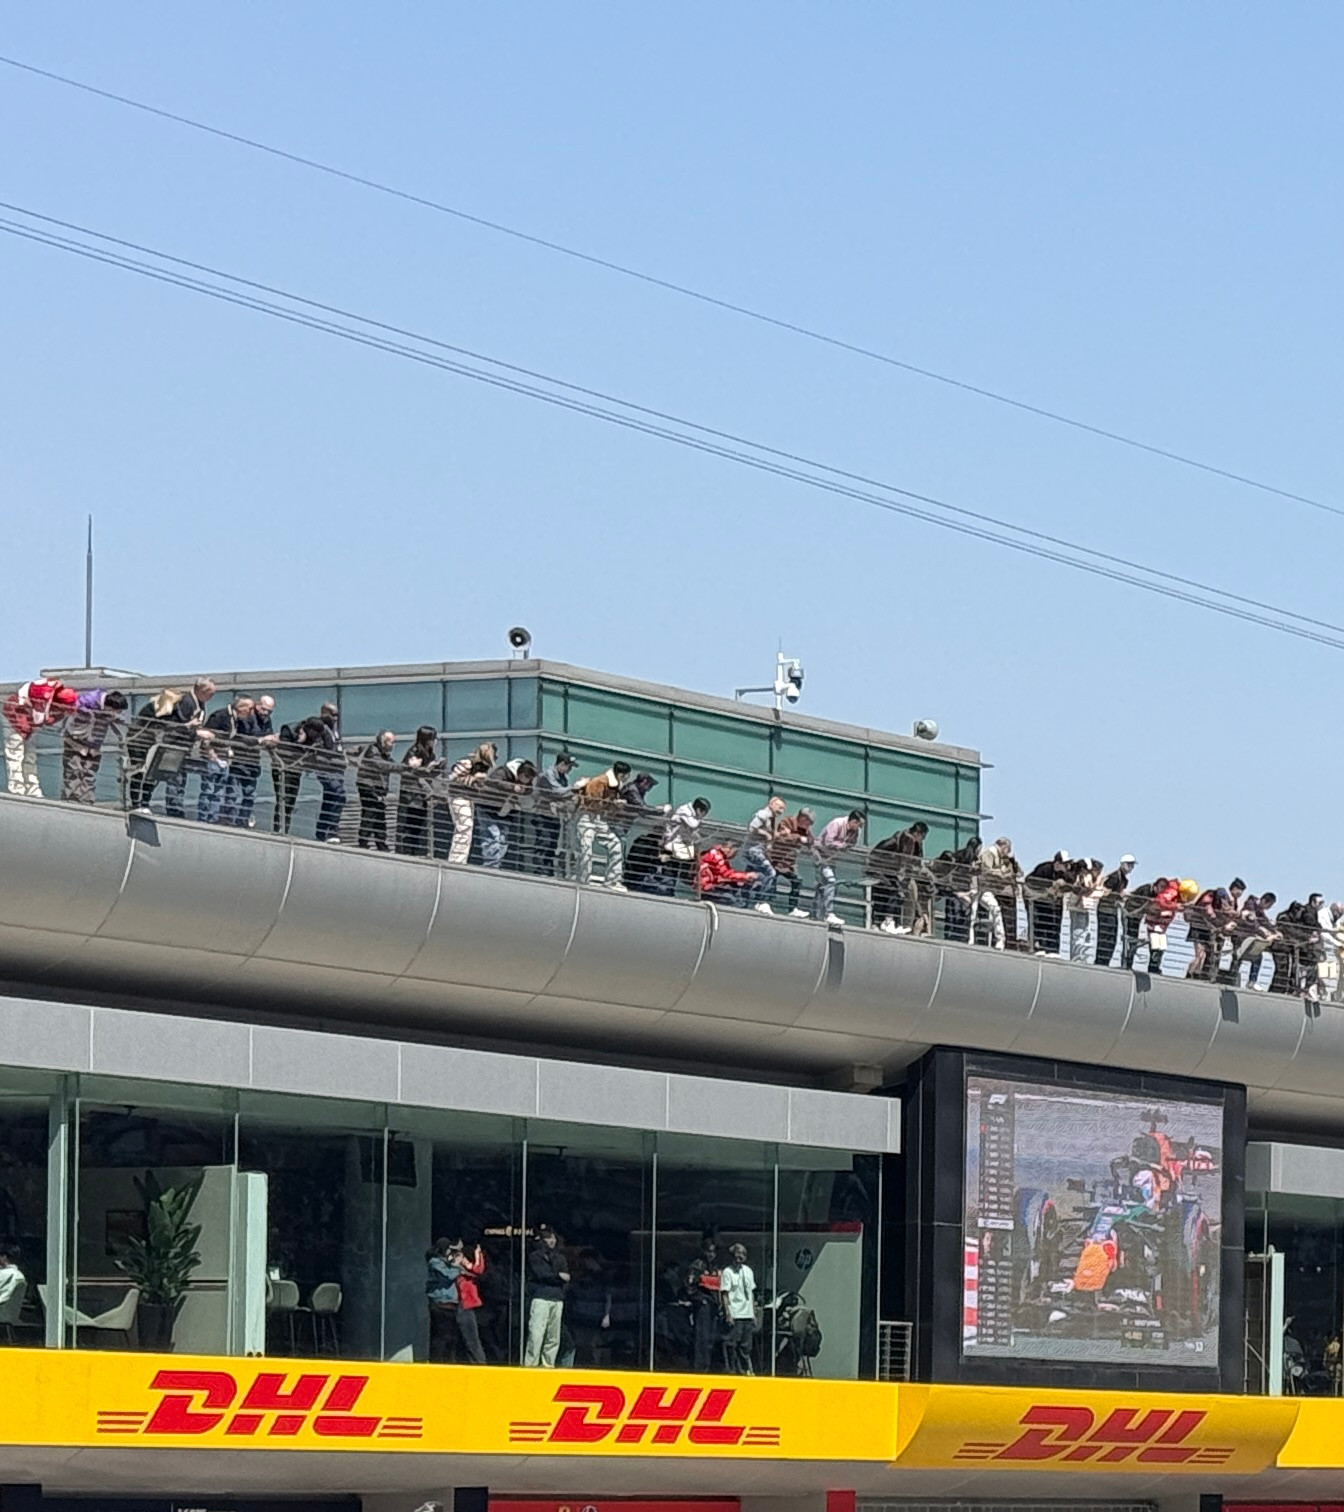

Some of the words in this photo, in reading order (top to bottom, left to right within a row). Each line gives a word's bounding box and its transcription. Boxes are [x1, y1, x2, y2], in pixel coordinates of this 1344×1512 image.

[142, 1369, 384, 1438] DHL
[547, 1383, 747, 1445] DHL
[994, 1405, 1208, 1464] DHL
